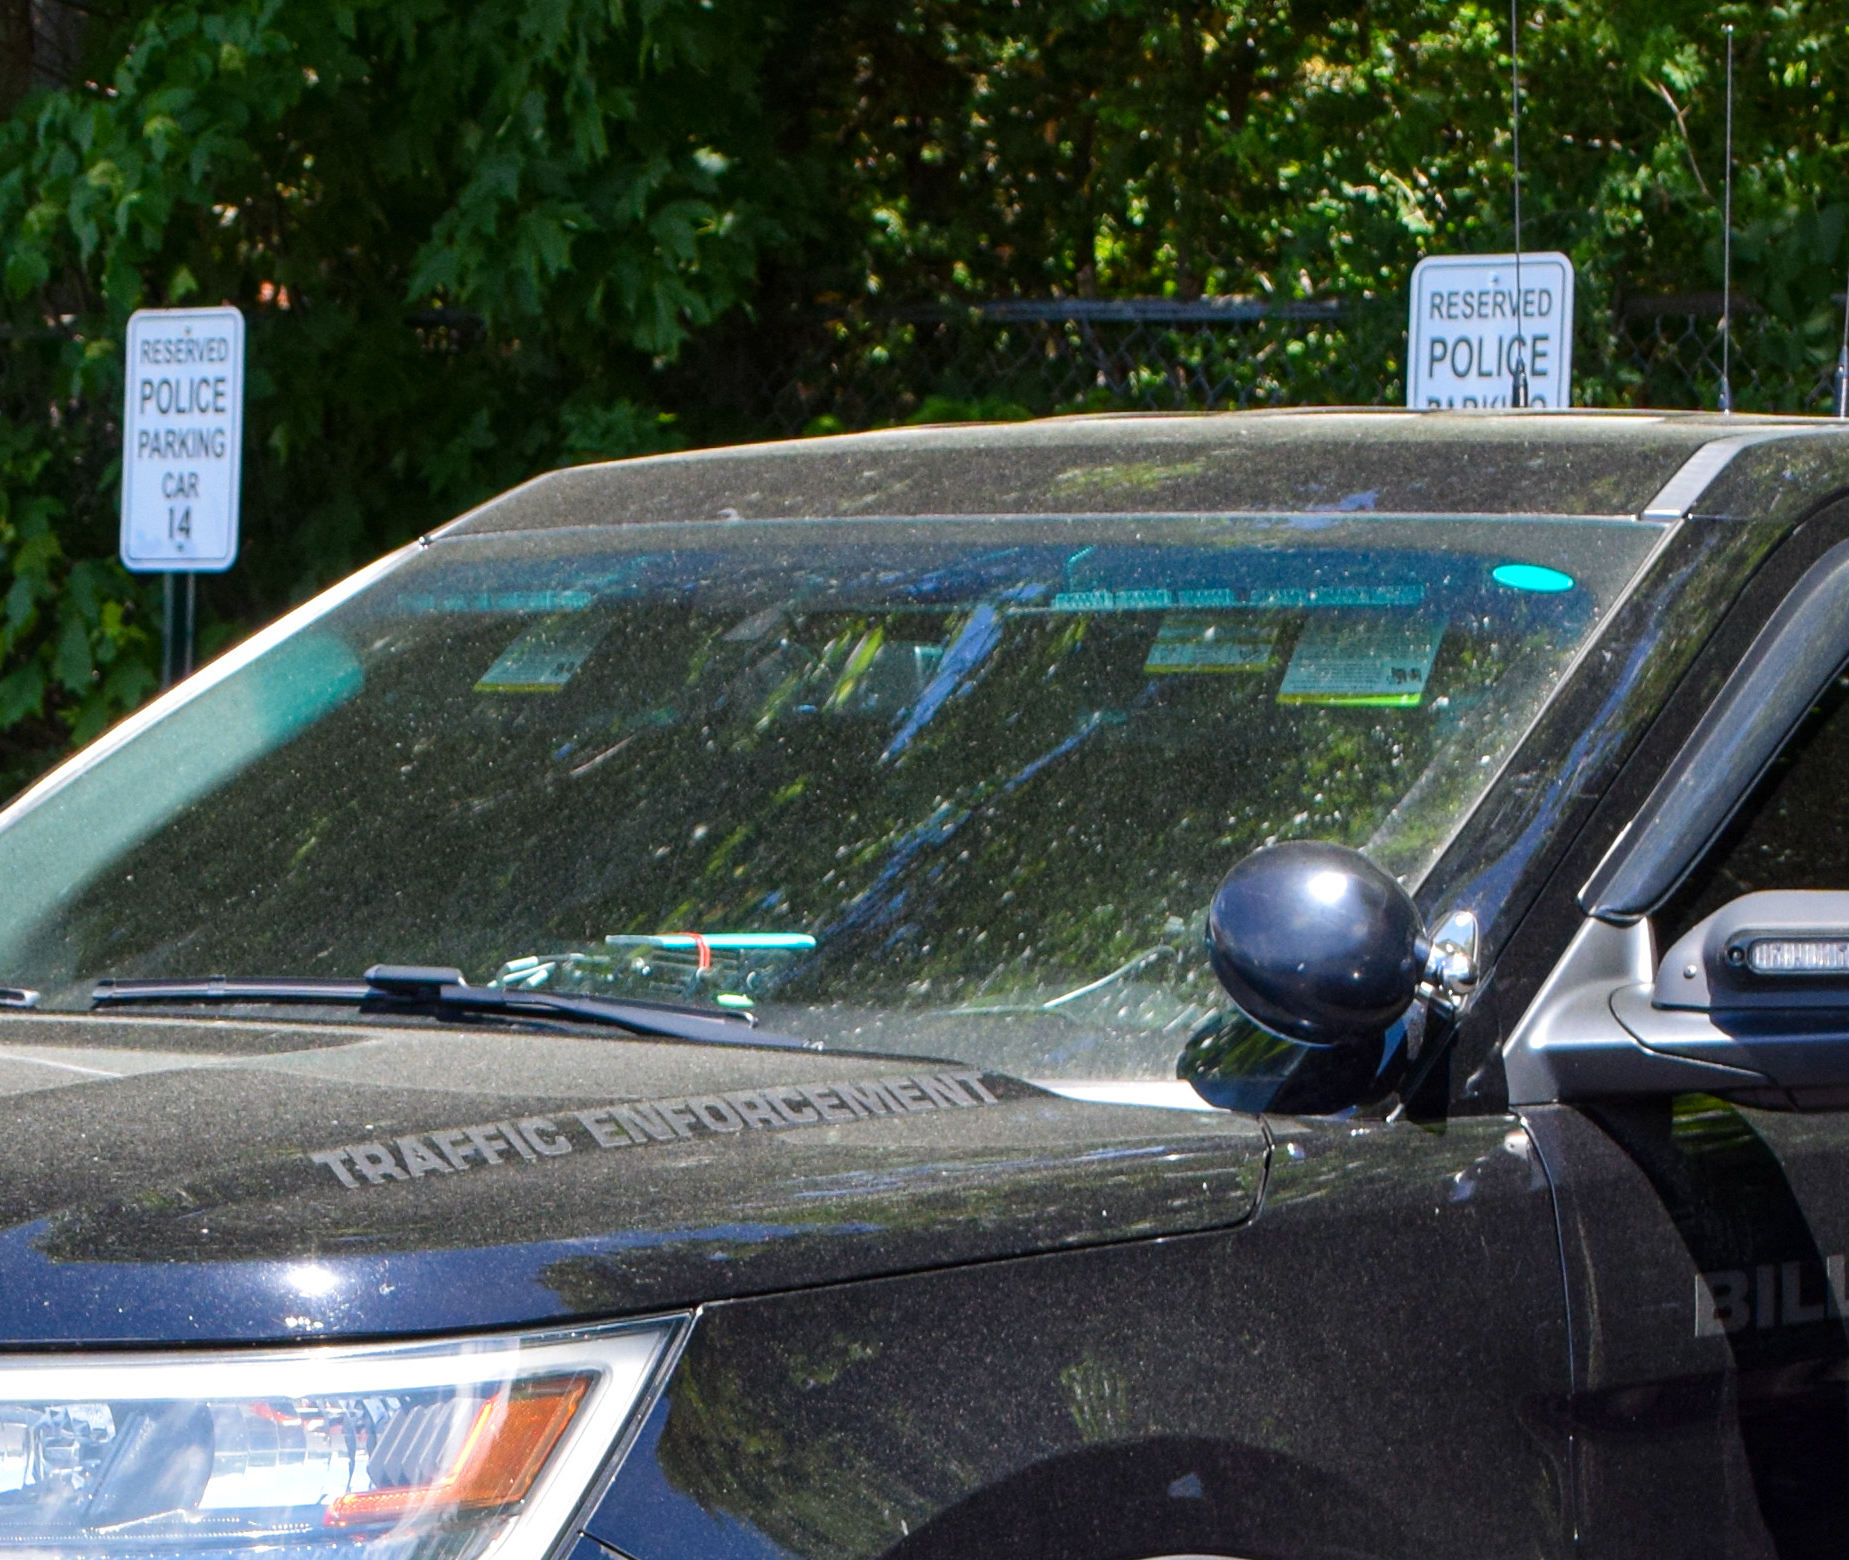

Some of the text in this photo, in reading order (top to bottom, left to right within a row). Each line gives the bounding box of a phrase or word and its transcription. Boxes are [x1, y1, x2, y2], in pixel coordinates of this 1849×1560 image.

[1429, 288, 1553, 320] RESERVED
[138, 336, 229, 365] RESERVED
[1427, 333, 1550, 379] POLICE
[139, 376, 227, 415] POLICE
[136, 428, 226, 459] PARKING
[160, 471, 200, 500] CAR
[167, 505, 192, 539] 14
[309, 1069, 1006, 1190] TRAFFIC ENFORCEMENT
